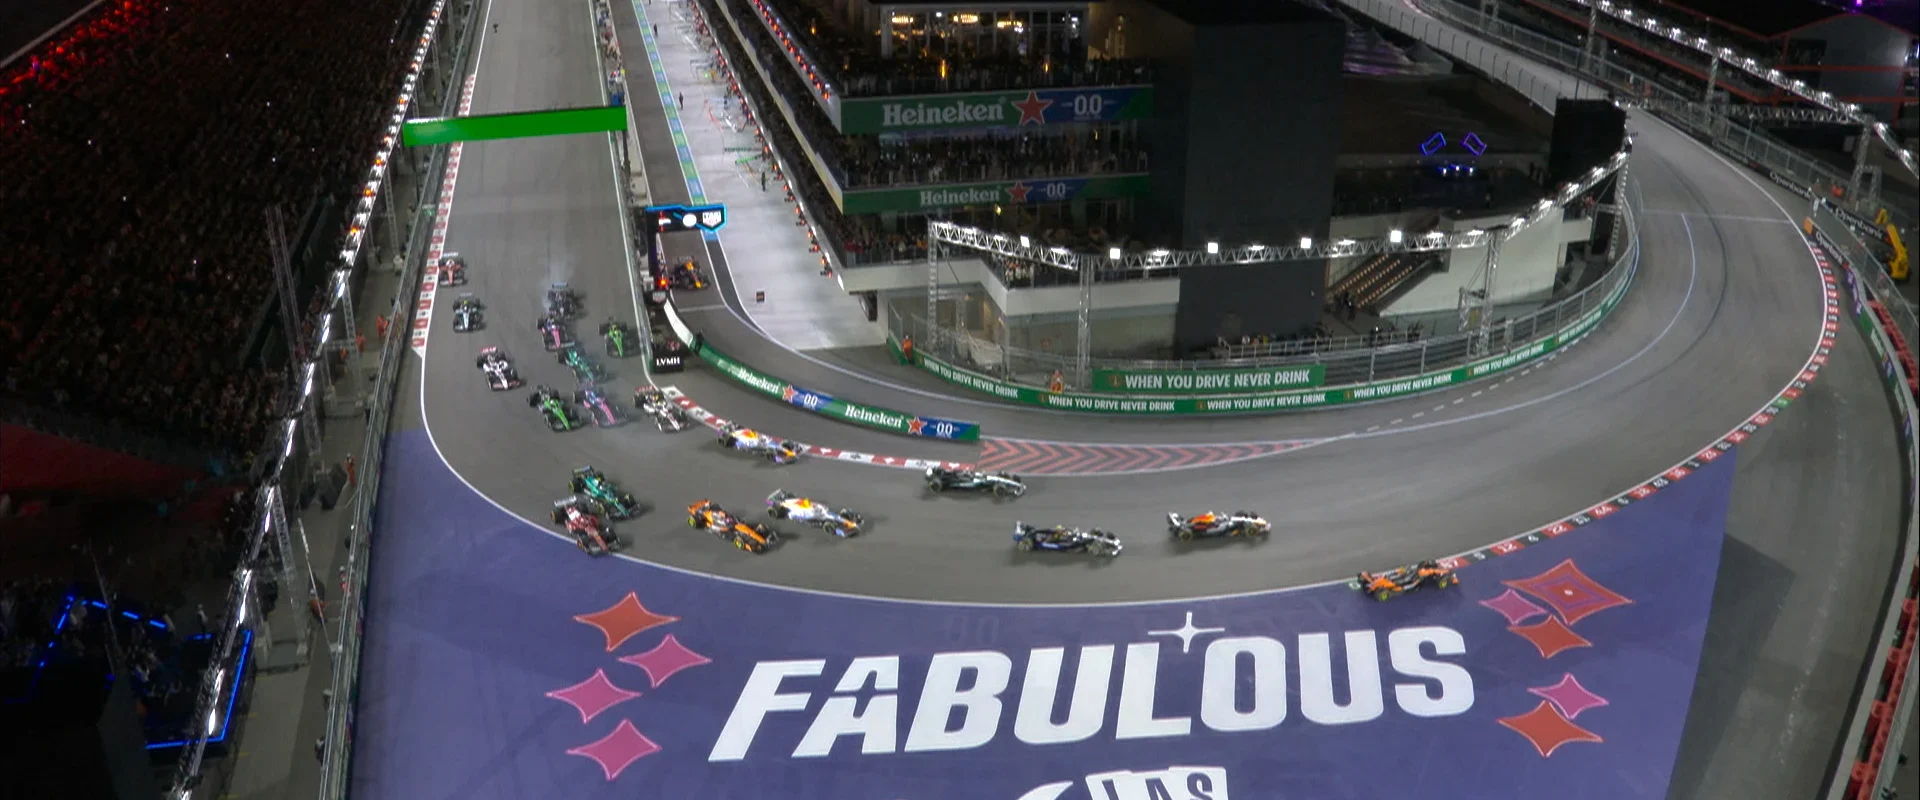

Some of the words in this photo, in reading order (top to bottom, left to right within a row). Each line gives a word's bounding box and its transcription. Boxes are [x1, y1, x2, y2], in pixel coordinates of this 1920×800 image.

[882, 100, 1004, 126] Heineken
[1770, 170, 1811, 199] Openbank
[920, 188, 999, 206] Heineken
[1836, 207, 1882, 239] Openbank
[656, 357, 680, 366] LVMH
[923, 357, 940, 373] WHEN
[940, 366, 952, 378] YOU
[952, 371, 972, 386] DRIVE
[973, 378, 994, 393] NEVER
[995, 385, 1018, 398] DRINK
[1125, 374, 1163, 389] WHEN
[1166, 374, 1192, 389] YOU
[1195, 373, 1231, 388] DRIVE
[1234, 371, 1271, 387] NEVER
[1274, 369, 1310, 385] DRINK
[1353, 388, 1375, 398] WHEN
[1376, 384, 1391, 396] YOU
[1391, 381, 1411, 393] DRIVE
[1412, 378, 1432, 390] NEVER
[1433, 373, 1452, 386] DRINK
[1048, 395, 1073, 407] WHEN
[1074, 398, 1093, 409] YOU
[1094, 400, 1119, 410] DRIVE
[1120, 401, 1147, 411] NEVER
[1149, 401, 1175, 411] DRINK
[1207, 400, 1231, 410] WHEN
[1234, 398, 1251, 409] YOU
[1252, 397, 1275, 408] DRIVE
[1277, 395, 1301, 406] NEVER
[1302, 393, 1326, 404] DRINK
[845, 405, 901, 428] Heineken
[708, 626, 1475, 762] FABULOUS
